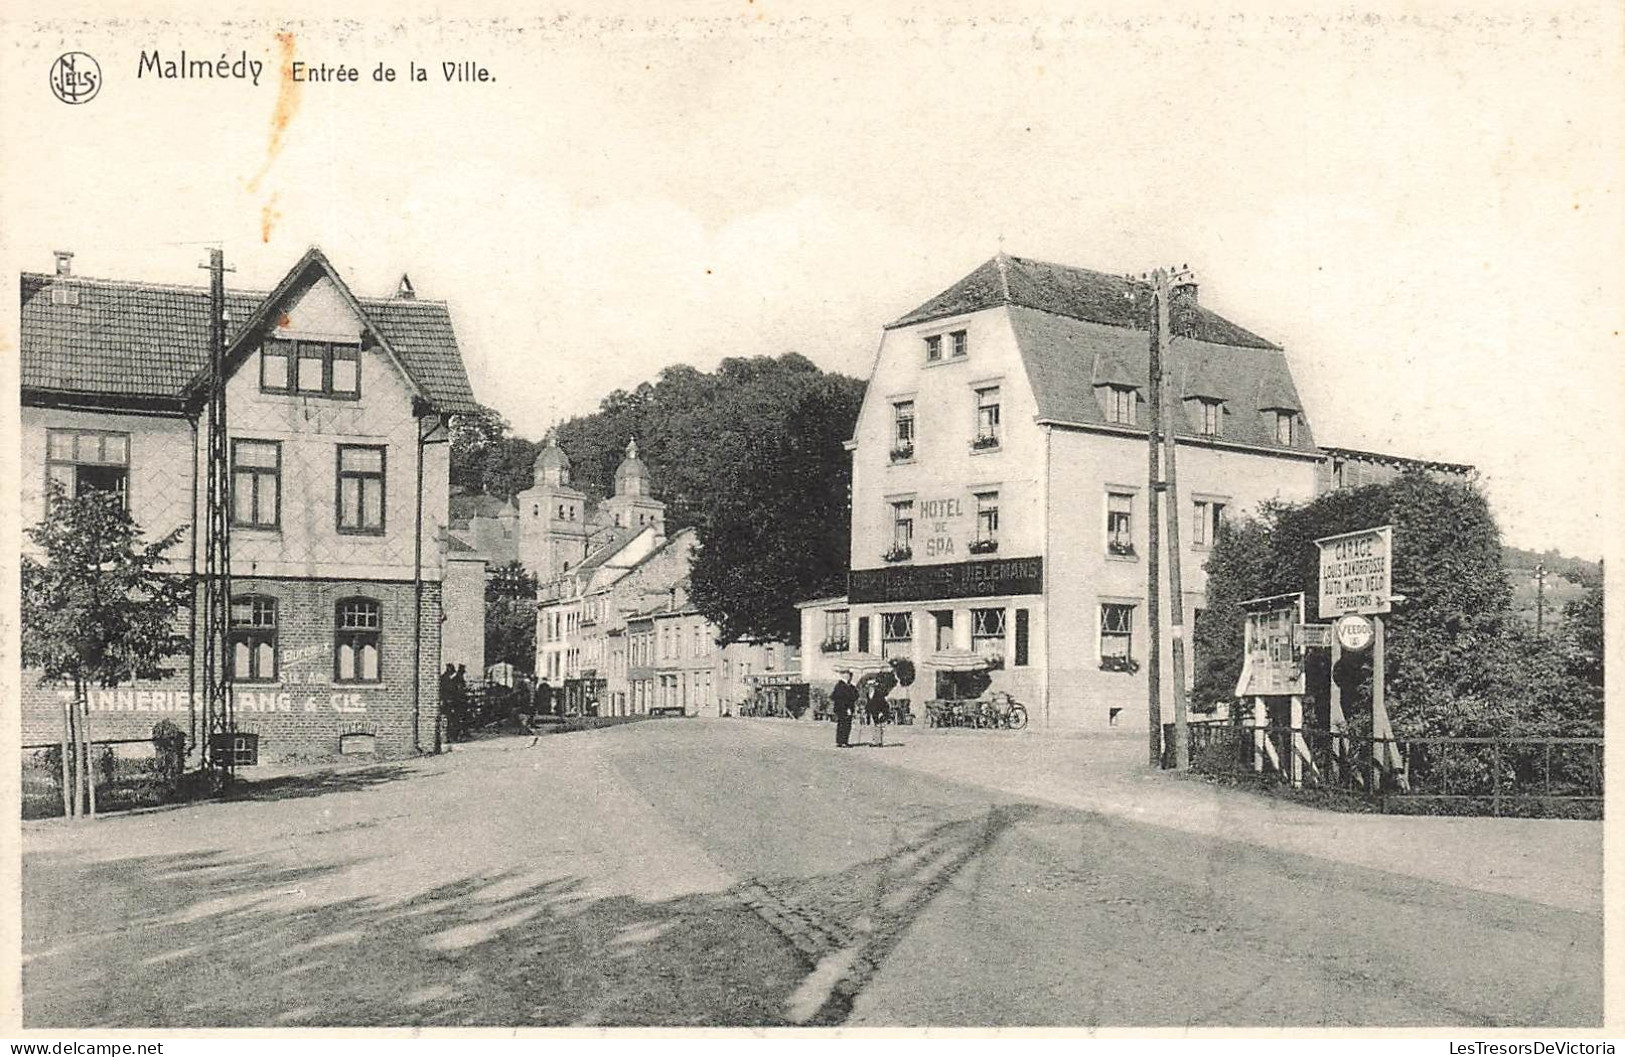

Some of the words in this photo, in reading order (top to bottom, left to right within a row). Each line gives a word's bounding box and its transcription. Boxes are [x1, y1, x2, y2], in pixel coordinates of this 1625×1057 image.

[920, 498, 963, 519] HOTEL
[935, 521, 947, 532] DE
[926, 537, 955, 556] SPA
[304, 697, 317, 712] &
